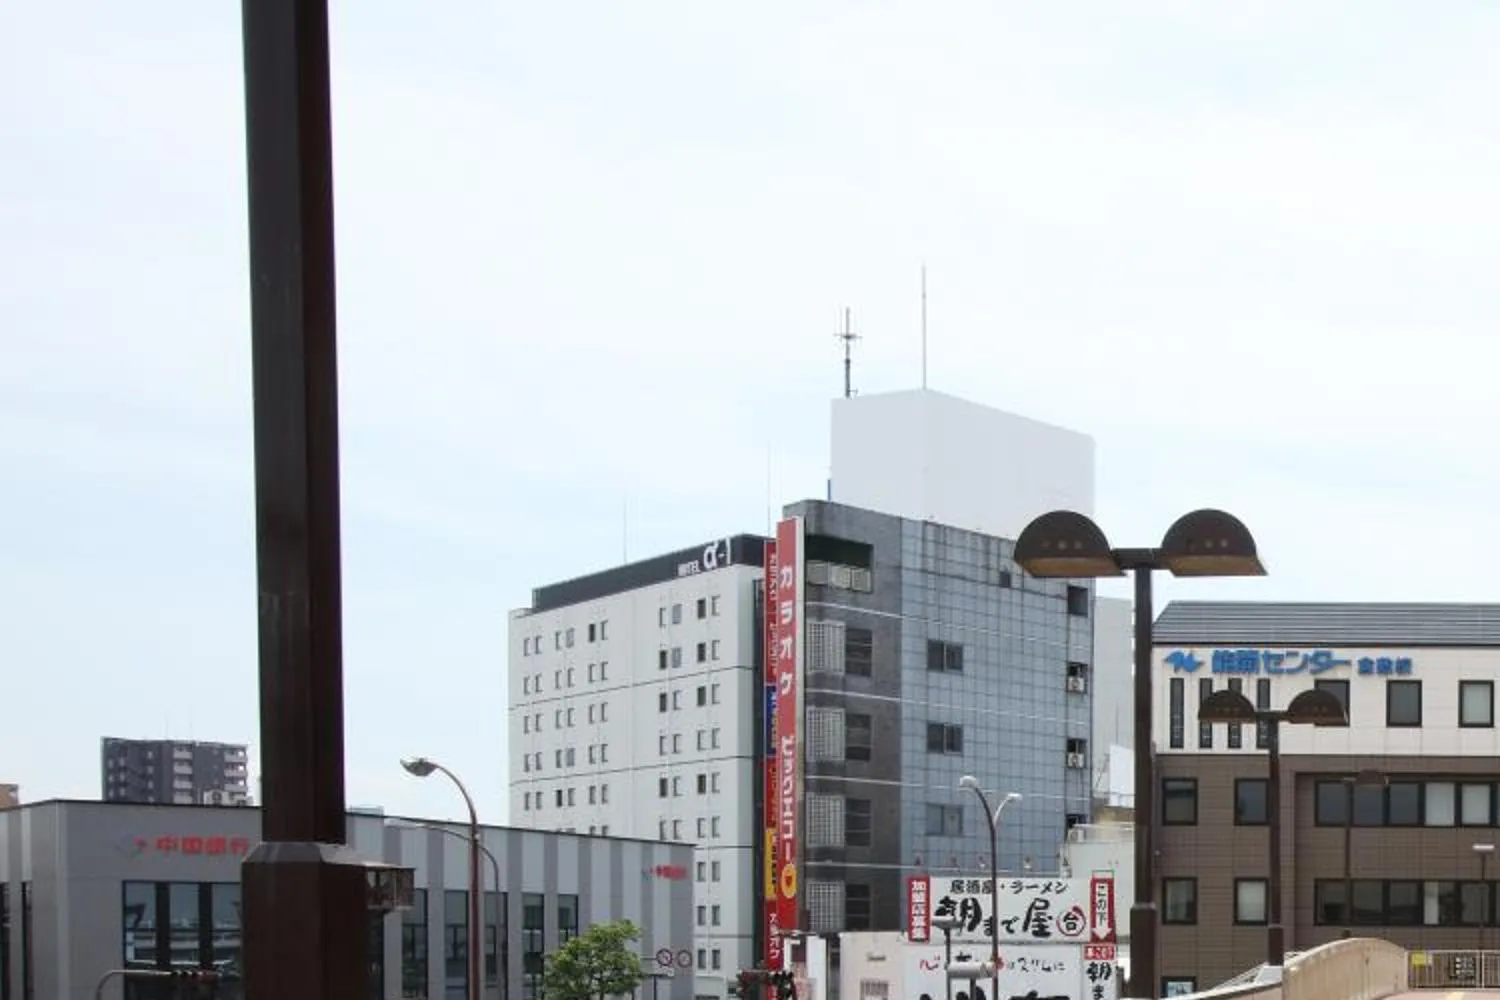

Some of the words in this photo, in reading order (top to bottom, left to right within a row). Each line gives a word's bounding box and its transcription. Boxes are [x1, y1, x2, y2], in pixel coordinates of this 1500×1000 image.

[780, 565, 793, 695] カラオケ
[781, 735, 794, 861] ビッグエコー
